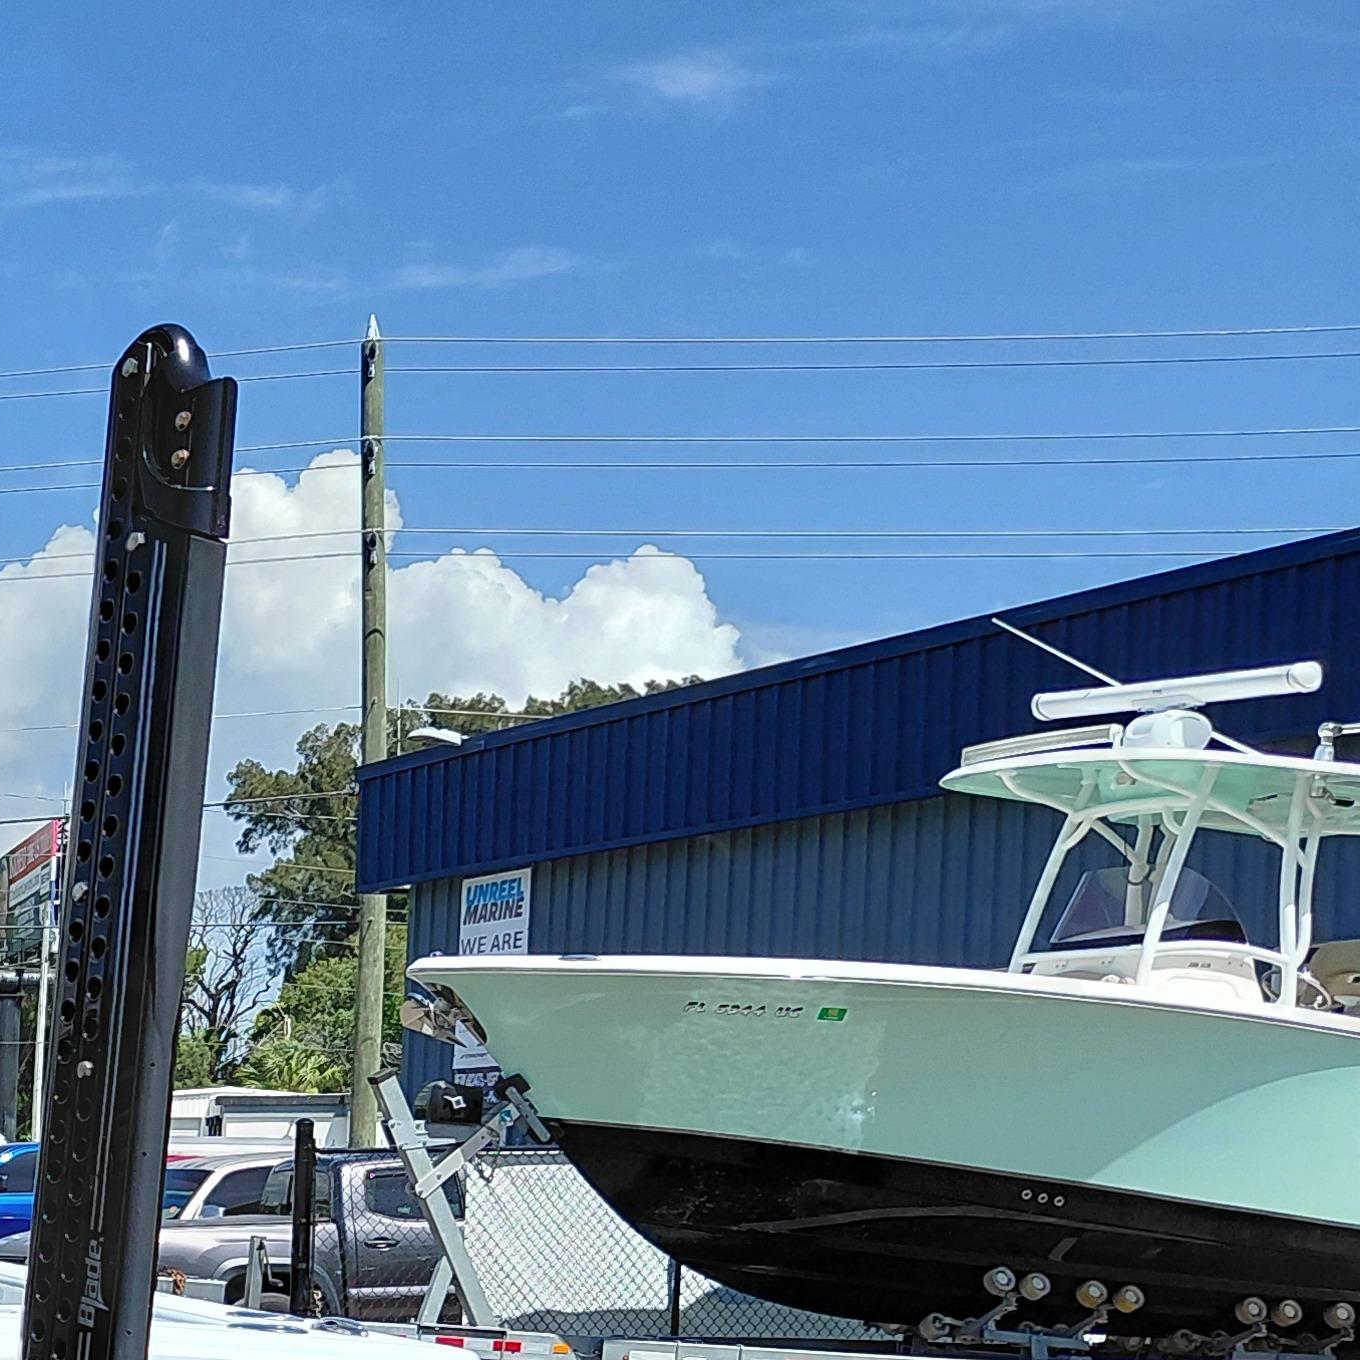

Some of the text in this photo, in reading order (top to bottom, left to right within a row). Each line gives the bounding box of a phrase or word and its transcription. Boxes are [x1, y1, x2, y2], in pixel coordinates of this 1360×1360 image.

[466, 877, 524, 904] UNREEL
[463, 897, 524, 925] MARINE
[461, 931, 523, 954] WE ARE
